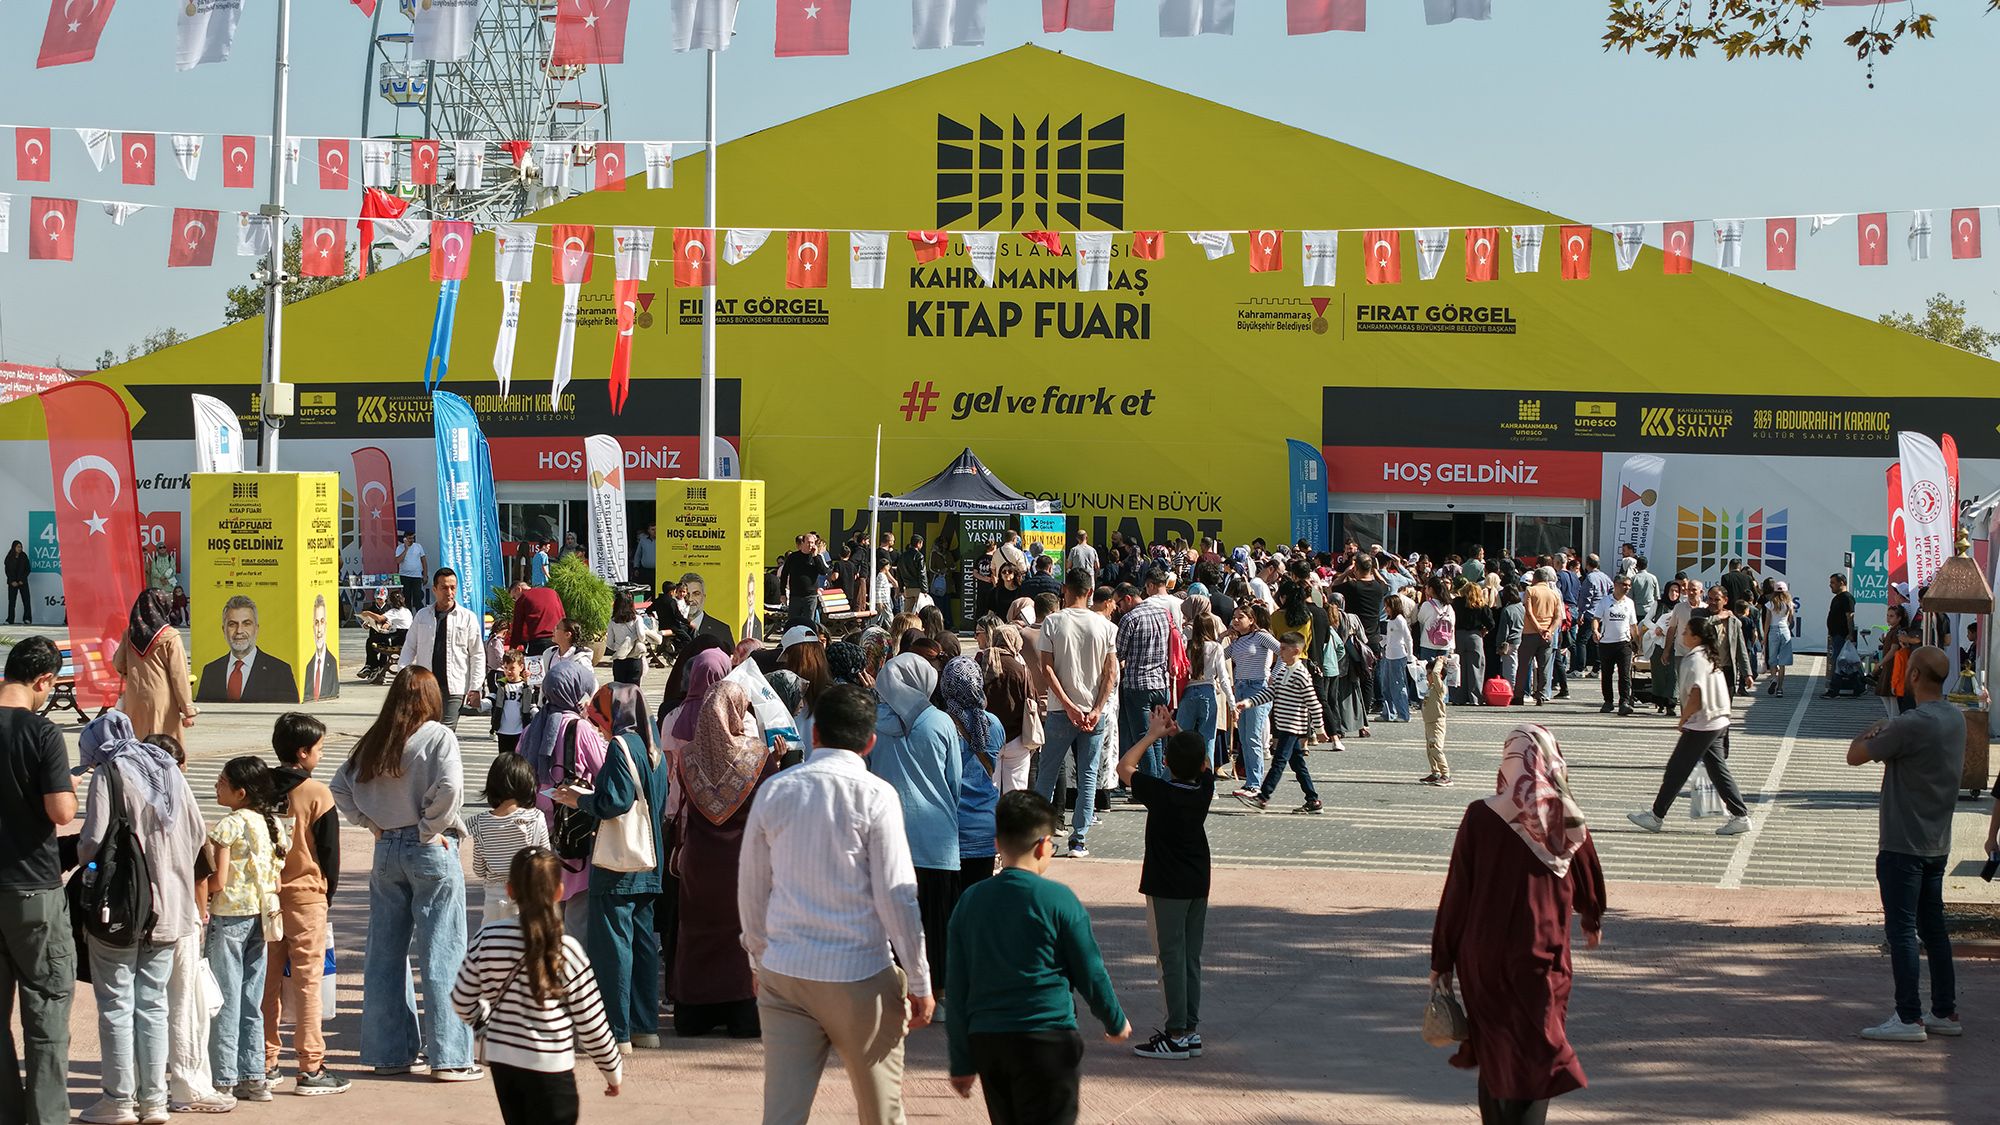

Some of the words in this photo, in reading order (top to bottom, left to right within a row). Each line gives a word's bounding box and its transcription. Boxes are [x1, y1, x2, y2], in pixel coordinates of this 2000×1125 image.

[680, 299, 738, 315] FIAT
[744, 296, 829, 315] GÖRGEL
[1238, 310, 1312, 321] Kahramanmaraş
[1357, 305, 1419, 321] FIRAT
[1425, 304, 1516, 323] GÖRGEL
[577, 317, 604, 328] yükşehir
[1035, 302, 1150, 340] FUARI
[1237, 321, 1275, 331] Büyükşehir
[1276, 321, 1312, 332] Belediyesi
[1358, 322, 1415, 331] KAHRAMANMARAŞ
[535, 393, 576, 414] KARKOÇ
[951, 386, 1003, 420] gel
[1006, 395, 1036, 413] ve
[1041, 385, 1117, 415] fark
[1120, 389, 1156, 416] et
[300, 408, 337, 416] unesco
[389, 412, 433, 422] SANAT
[1500, 423, 1558, 431] KAHRAMANMARAŞ
[1574, 418, 1617, 427] unesco
[1844, 411, 1891, 434] KARAKOÇ
[1677, 426, 1728, 438] SANAT
[1752, 430, 1795, 439] KÜLTÜR
[1802, 432, 1838, 440] SANAT
[538, 451, 583, 474] HOŞ
[625, 445, 681, 469] DİNİZ
[1383, 462, 1432, 487] HOŞ
[1436, 459, 1539, 484] GELDİNİZ
[154, 473, 191, 489] fark
[1129, 494, 1154, 510] EN
[1158, 491, 1222, 512] BÜYÜK
[219, 518, 245, 529] KİTAP
[246, 521, 272, 529] FUARI
[965, 518, 1005, 531] ŞERMİN
[1639, 510, 1650, 548] Belediyesi
[667, 529, 685, 541] HOŞ
[686, 528, 726, 539] GELDİNİZ
[967, 532, 1003, 544] YAŞAR
[208, 538, 231, 553] HOŞ
[233, 535, 284, 550] GELDİNİZ
[964, 558, 974, 596] HARFLİ
[964, 598, 974, 620] ALTI
